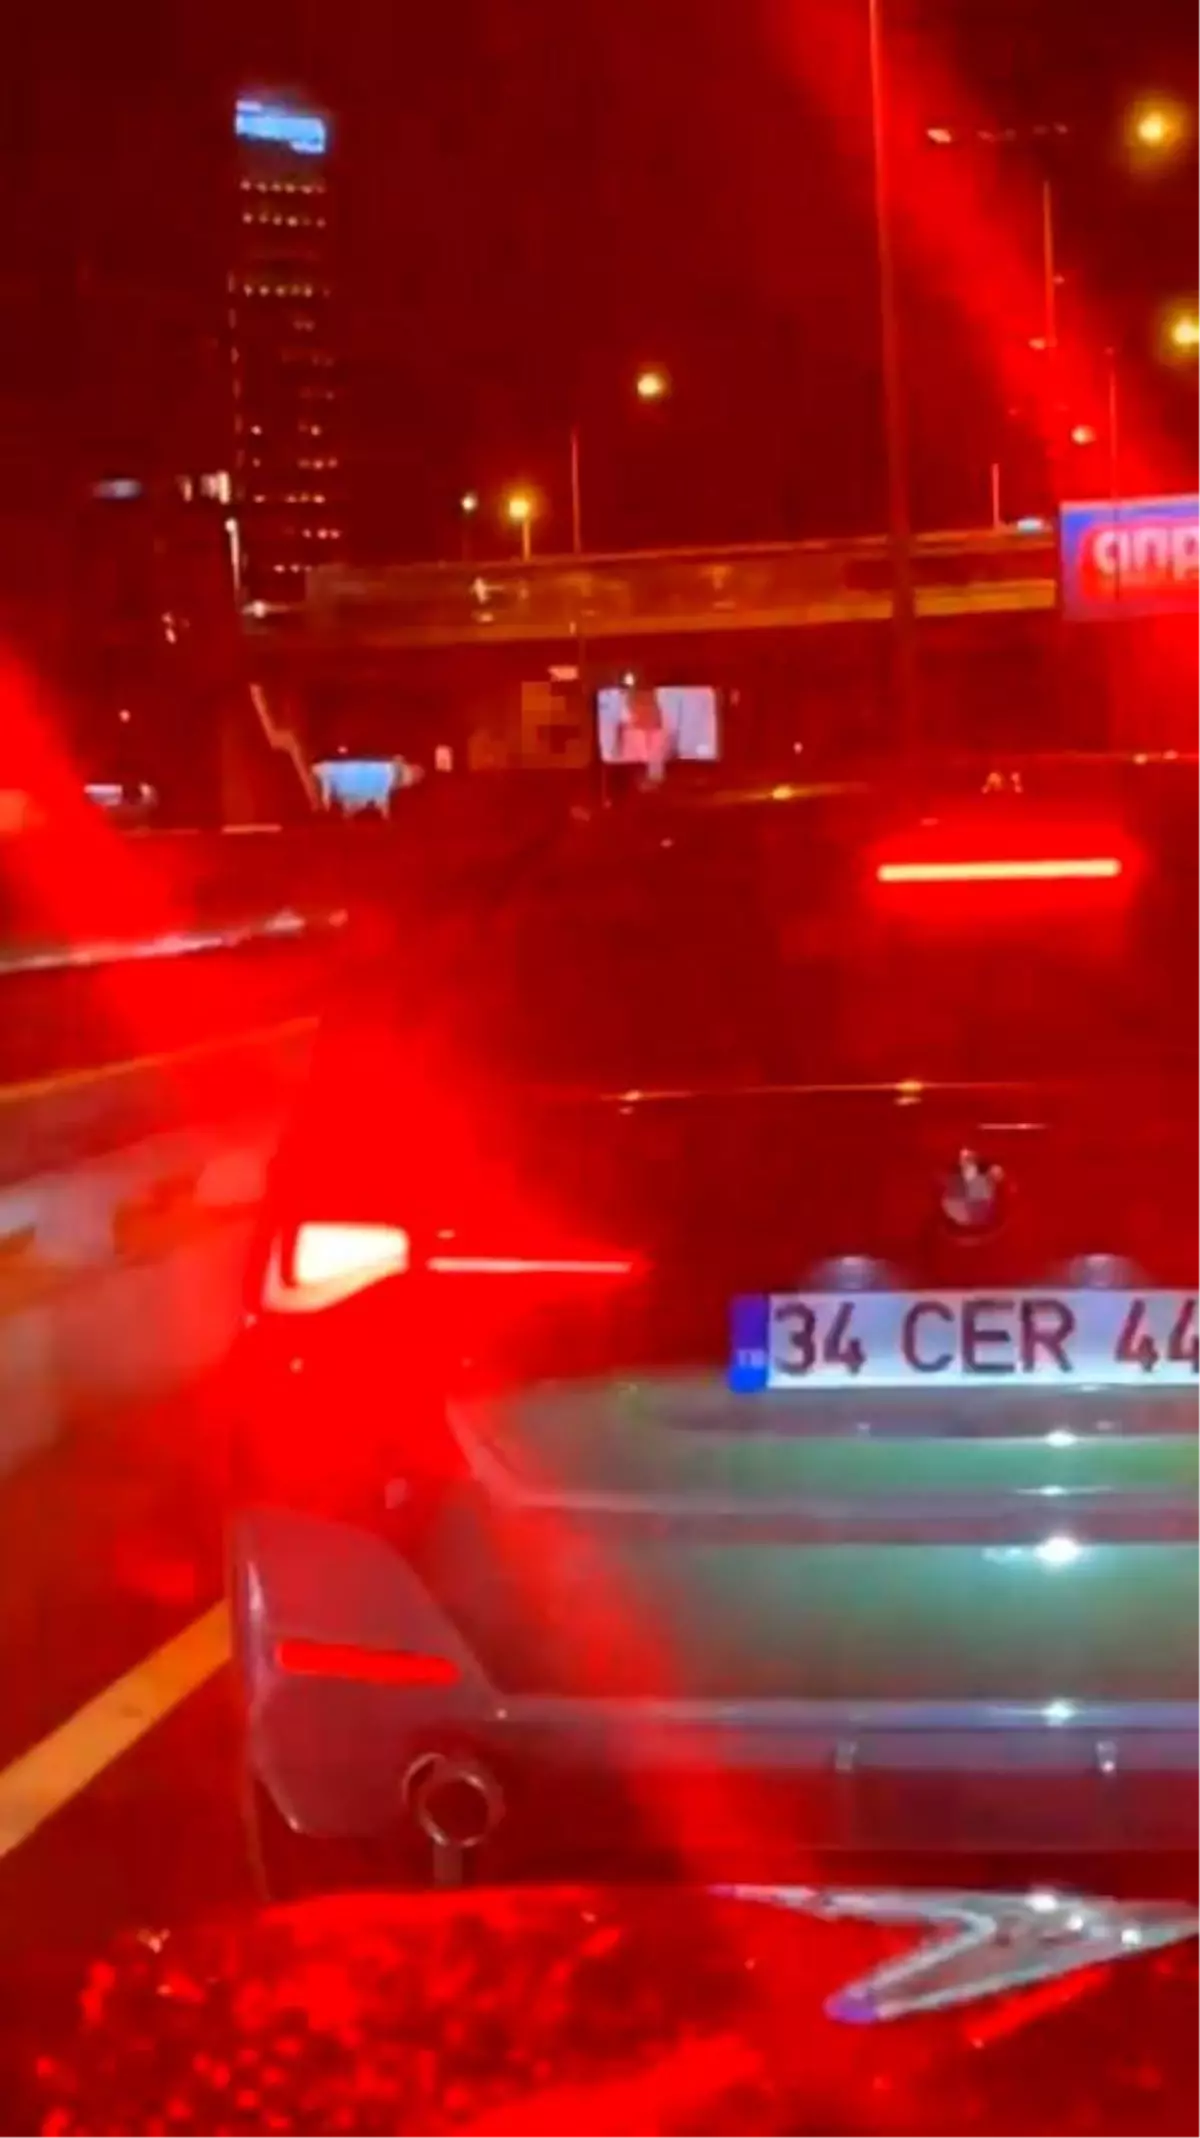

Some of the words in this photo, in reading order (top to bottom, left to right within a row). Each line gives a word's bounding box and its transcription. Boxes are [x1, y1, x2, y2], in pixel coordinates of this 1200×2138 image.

[774, 1301, 866, 1375] 34
[902, 1299, 1075, 1373] CER
[1114, 1297, 1200, 1373] 44
